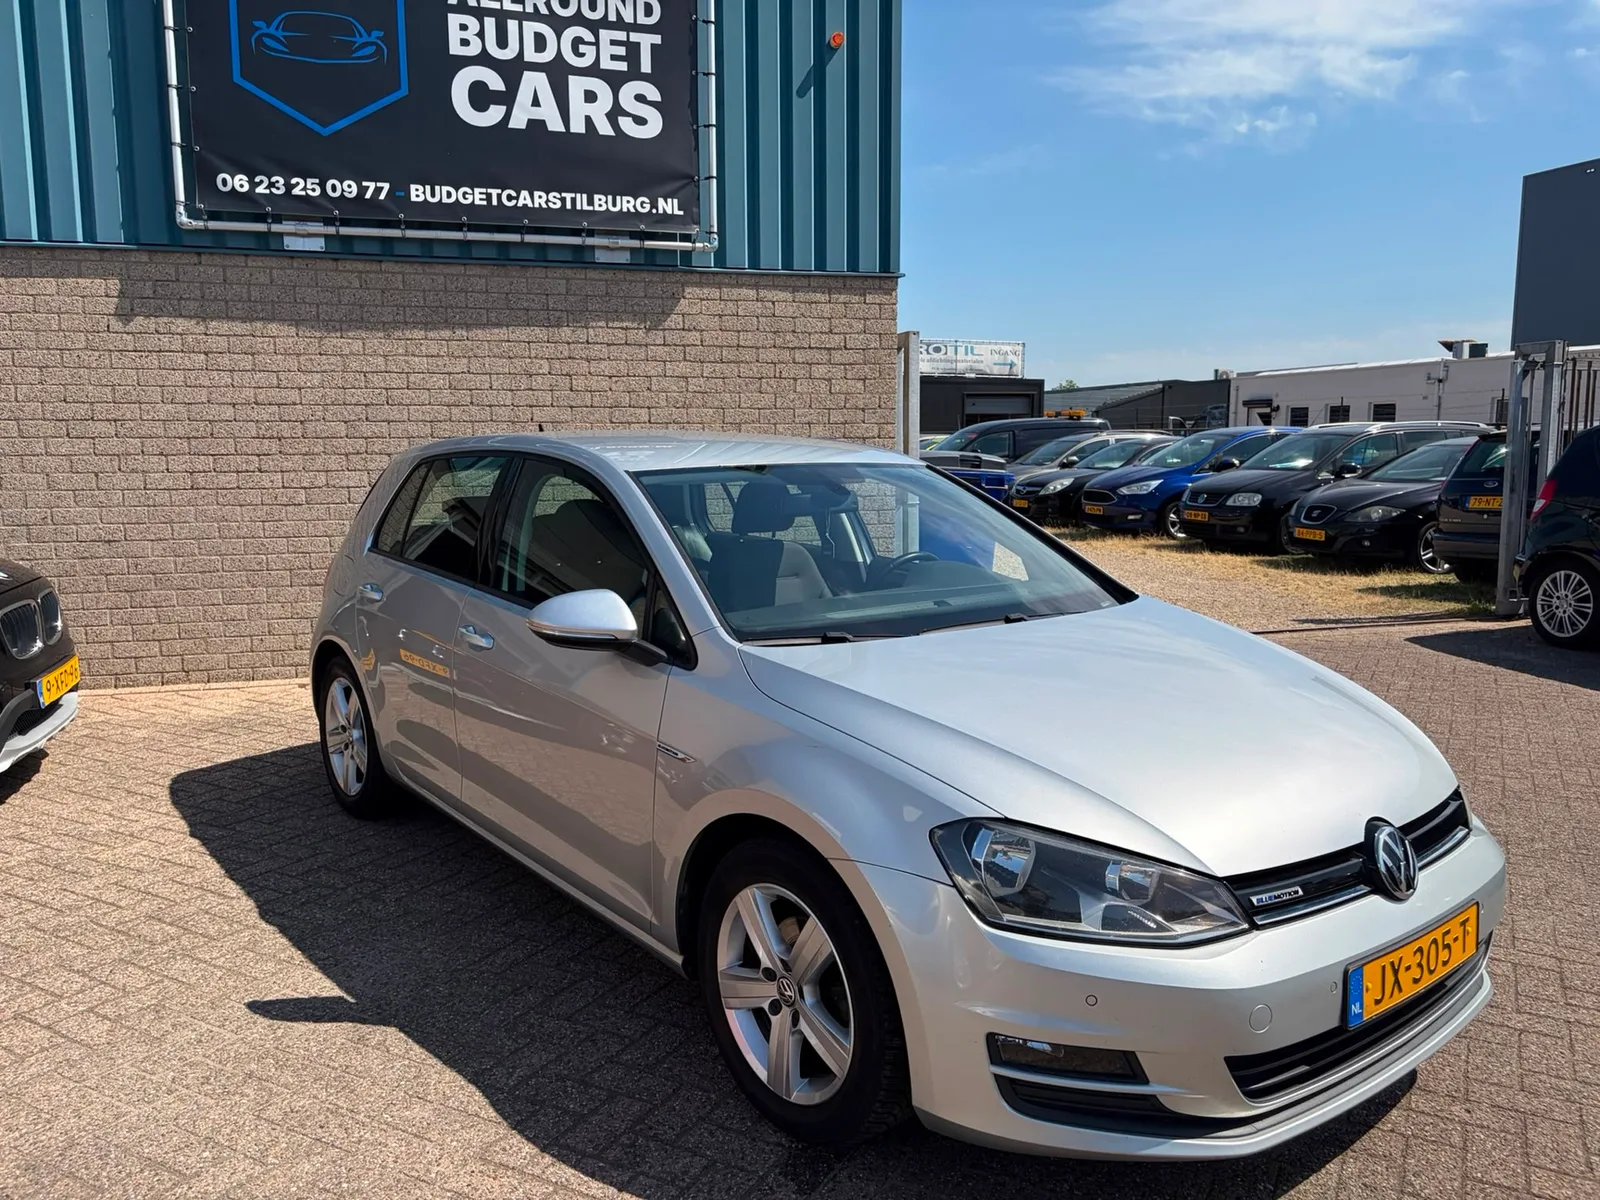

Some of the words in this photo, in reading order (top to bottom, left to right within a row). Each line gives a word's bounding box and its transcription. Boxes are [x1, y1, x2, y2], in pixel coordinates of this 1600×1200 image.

[447, 0, 662, 25] OUND
[447, 13, 662, 74] BUDGET
[451, 65, 663, 139] CARS
[216, 173, 249, 193] 06
[254, 175, 286, 195] 23
[290, 177, 321, 197] 25
[325, 179, 358, 198] 09
[361, 181, 390, 200] 77
[409, 183, 684, 215] BUDGETCARSTILBURG.NL
[990, 348, 1020, 357] INGANG
[45, 659, 79, 700] 9-XFD-96
[1373, 916, 1470, 1006] JX-305-T
[1351, 1001, 1363, 1016] NL
